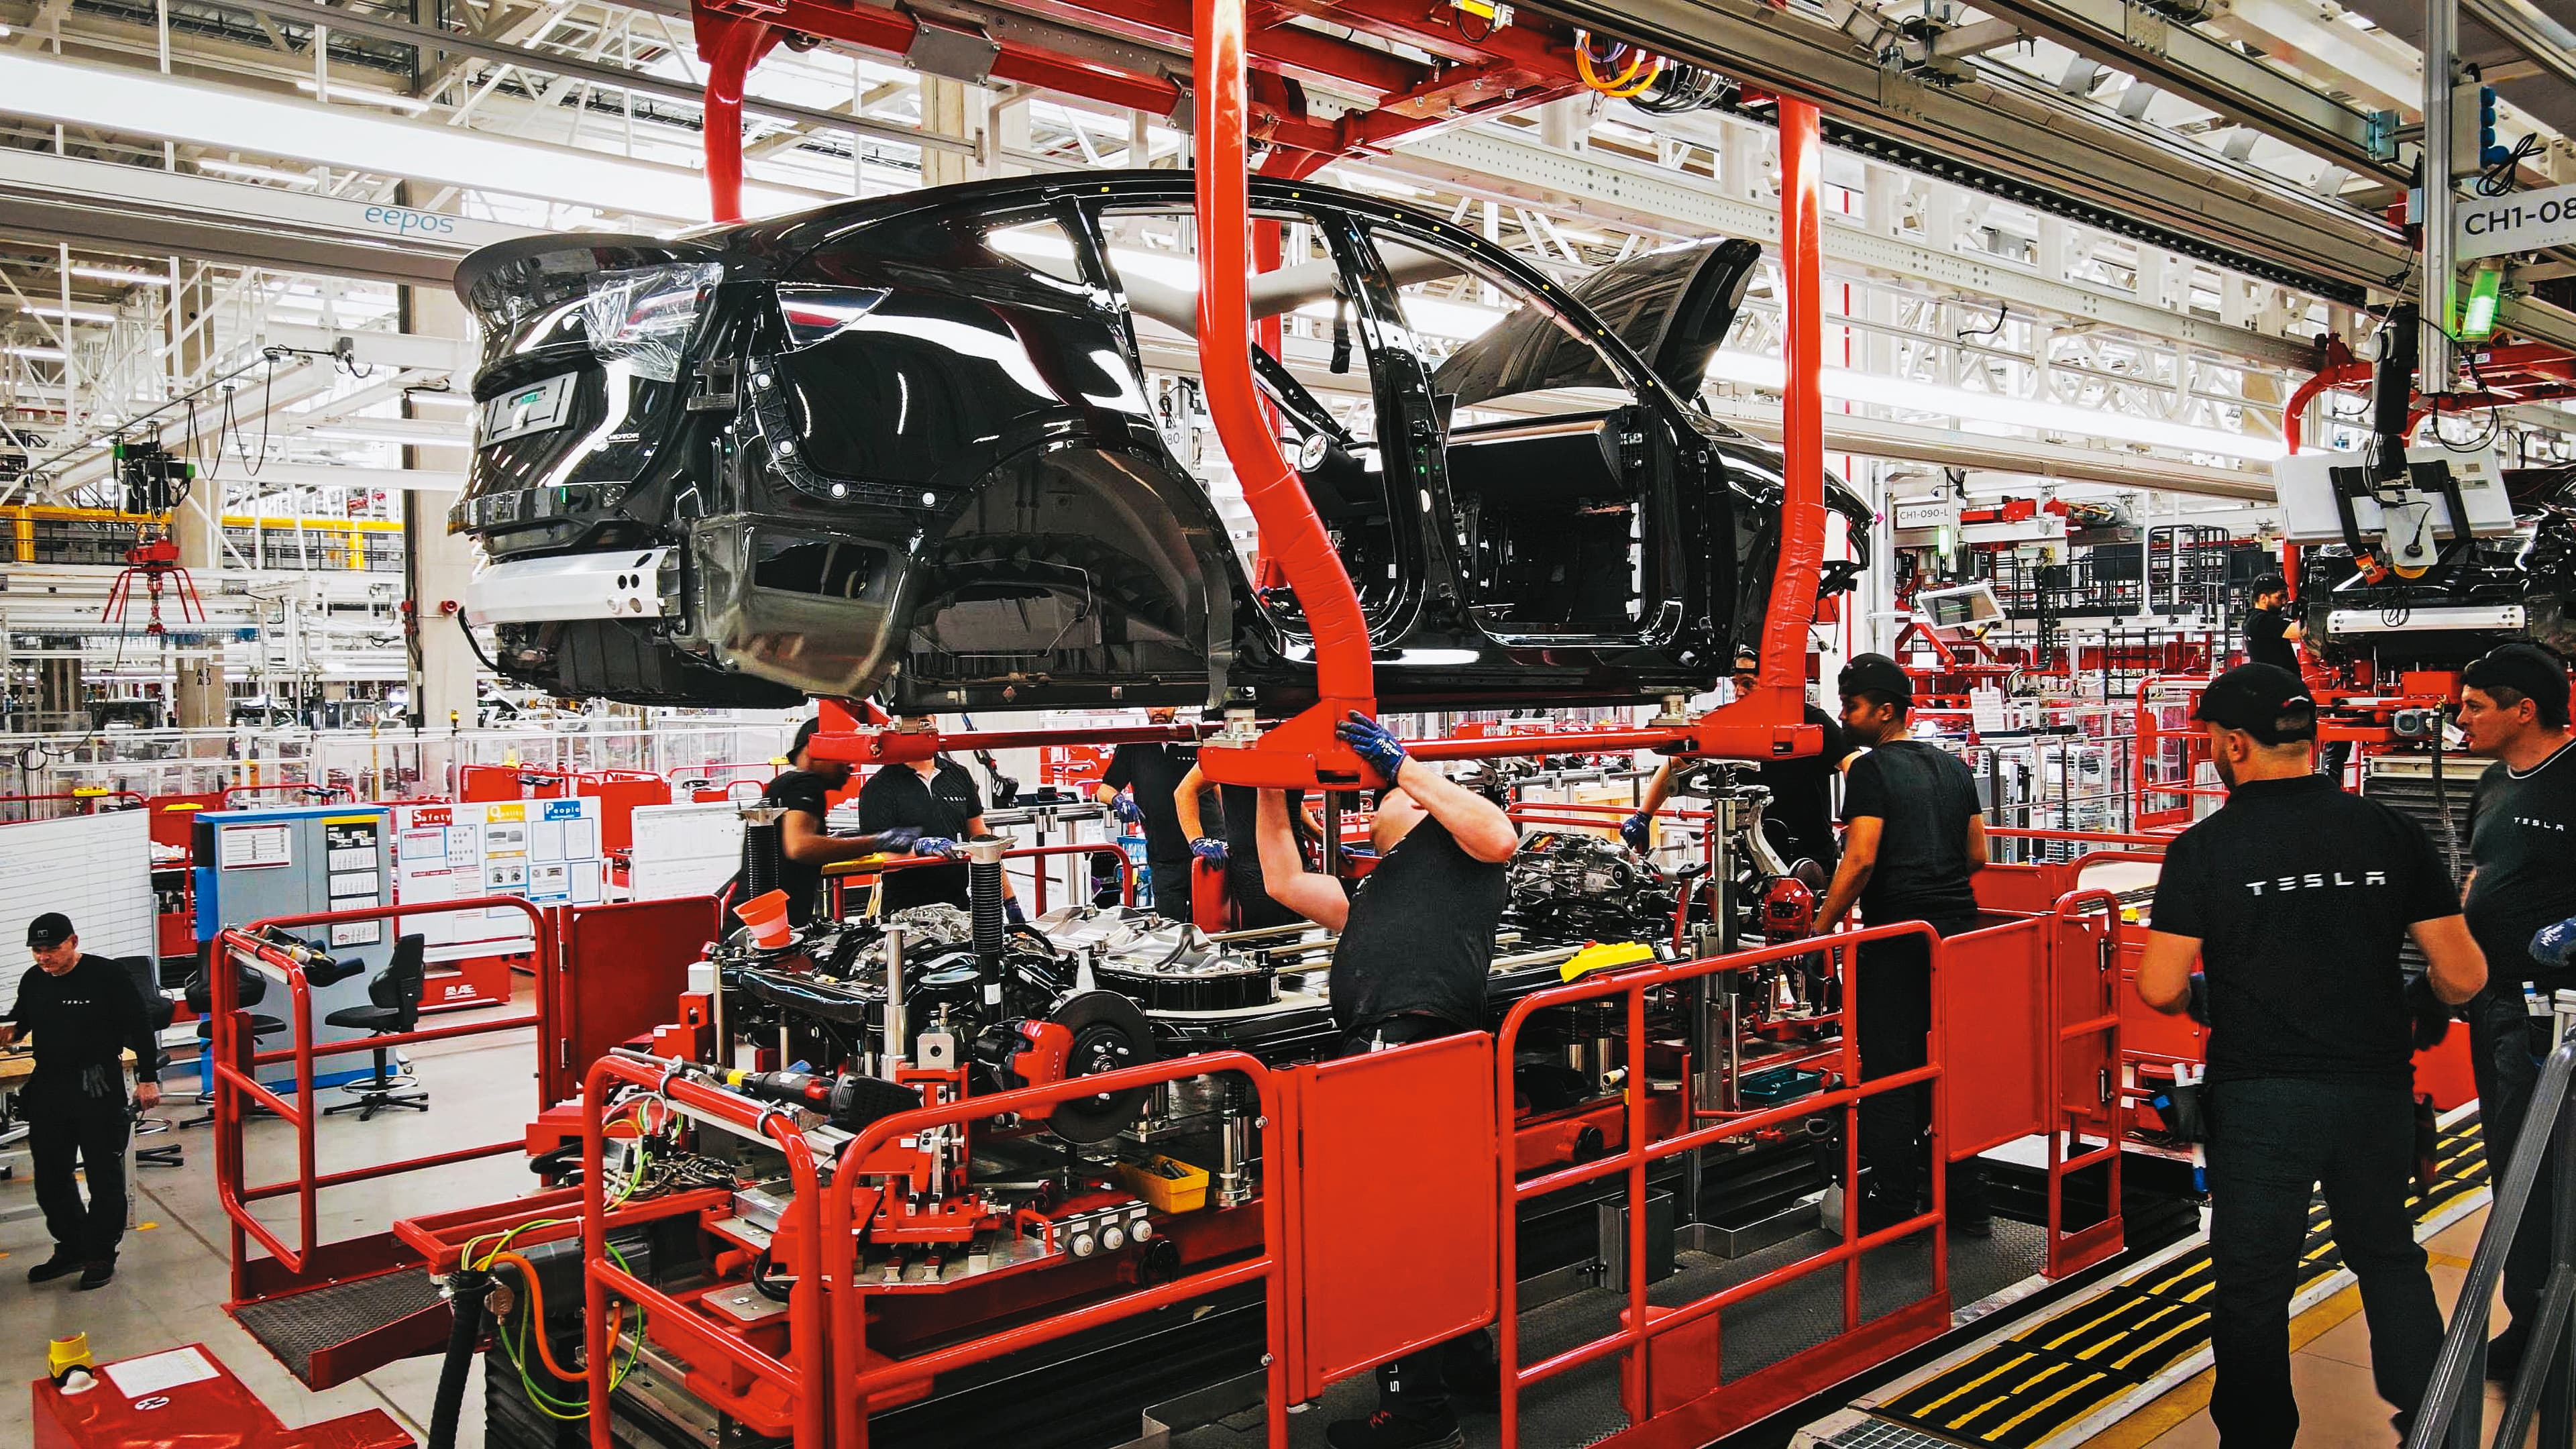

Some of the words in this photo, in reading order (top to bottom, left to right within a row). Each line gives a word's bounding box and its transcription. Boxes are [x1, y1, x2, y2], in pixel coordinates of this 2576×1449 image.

[365, 207, 454, 235] eepos
[413, 810, 451, 822] Safety
[545, 803, 580, 815] People
[2514, 817, 2564, 831] TESLA
[2245, 871, 2386, 896] TESLA
